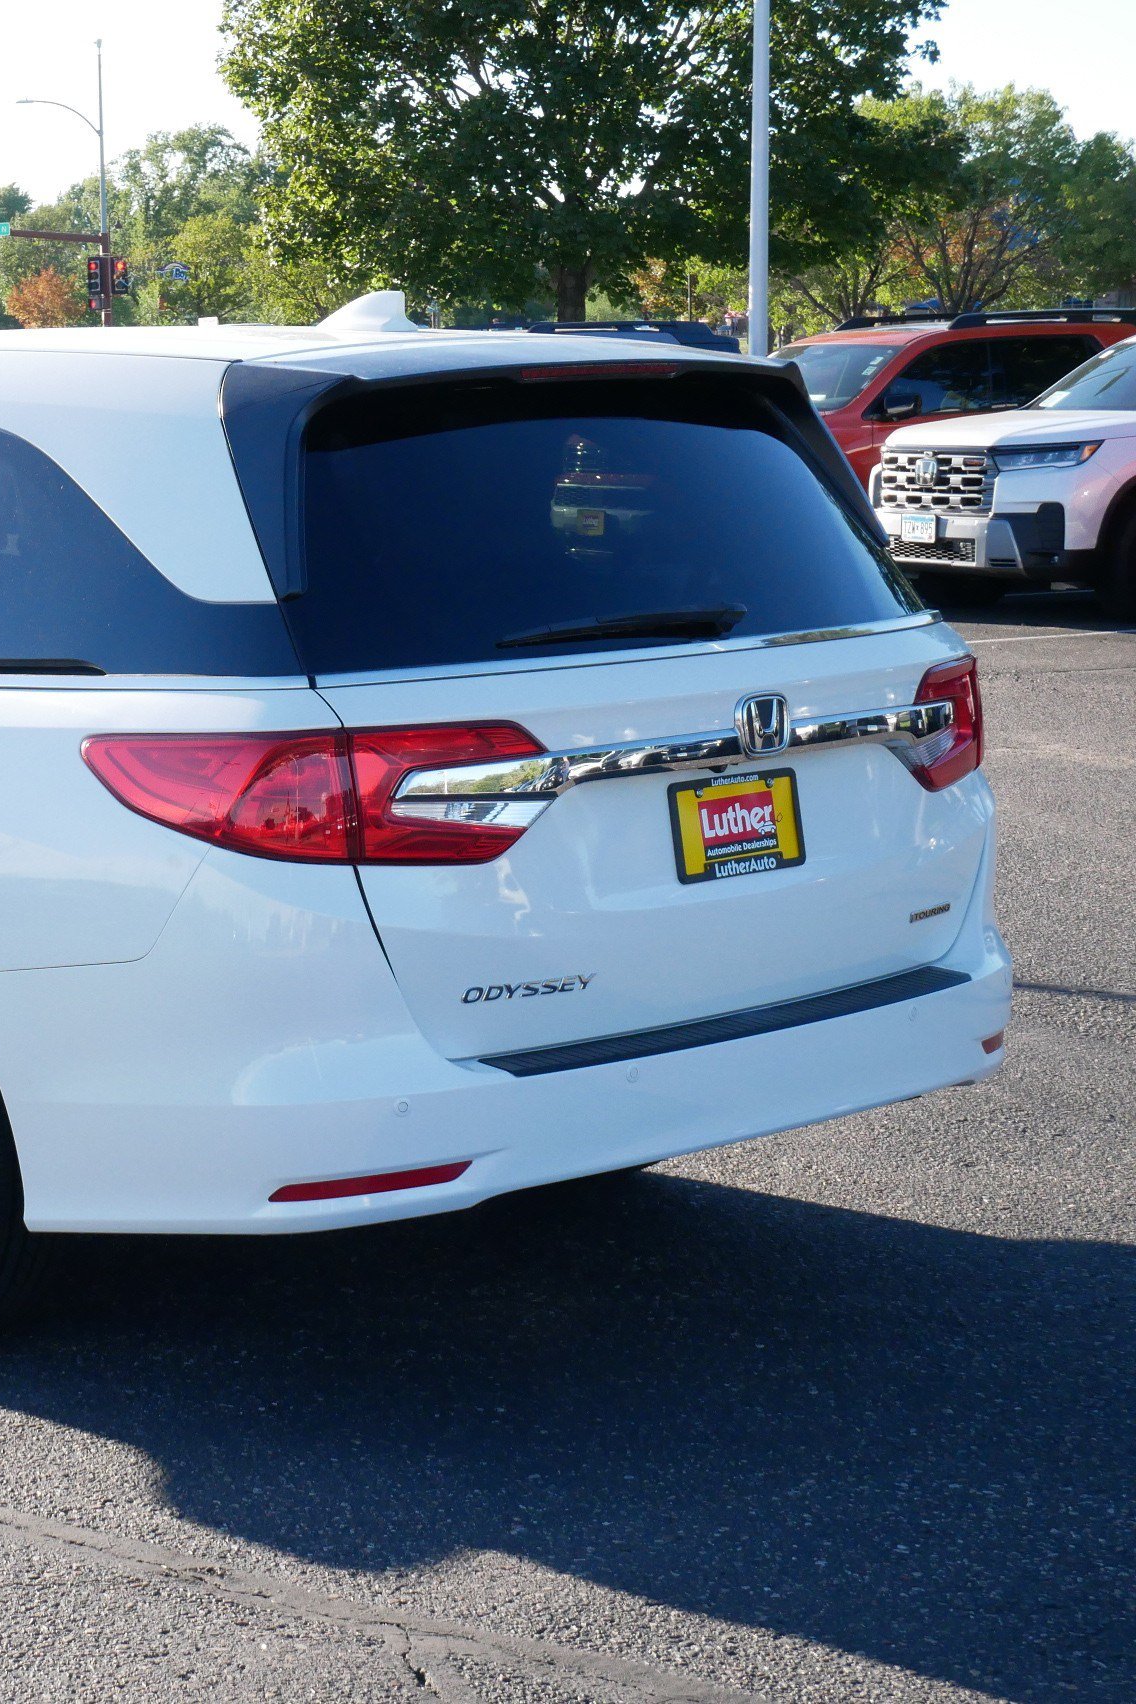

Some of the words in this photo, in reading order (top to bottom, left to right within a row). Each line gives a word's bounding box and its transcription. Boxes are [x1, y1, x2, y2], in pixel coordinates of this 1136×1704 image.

[1, 225, 7, 233] N
[711, 774, 759, 786] LutherAuto.com
[701, 803, 773, 838] Luther
[707, 844, 742, 857] Automobile
[743, 838, 777, 850] Dealerships
[715, 856, 777, 877] LutherAuto
[914, 903, 951, 920] TOURING
[462, 973, 597, 1004] ODYSSEY
